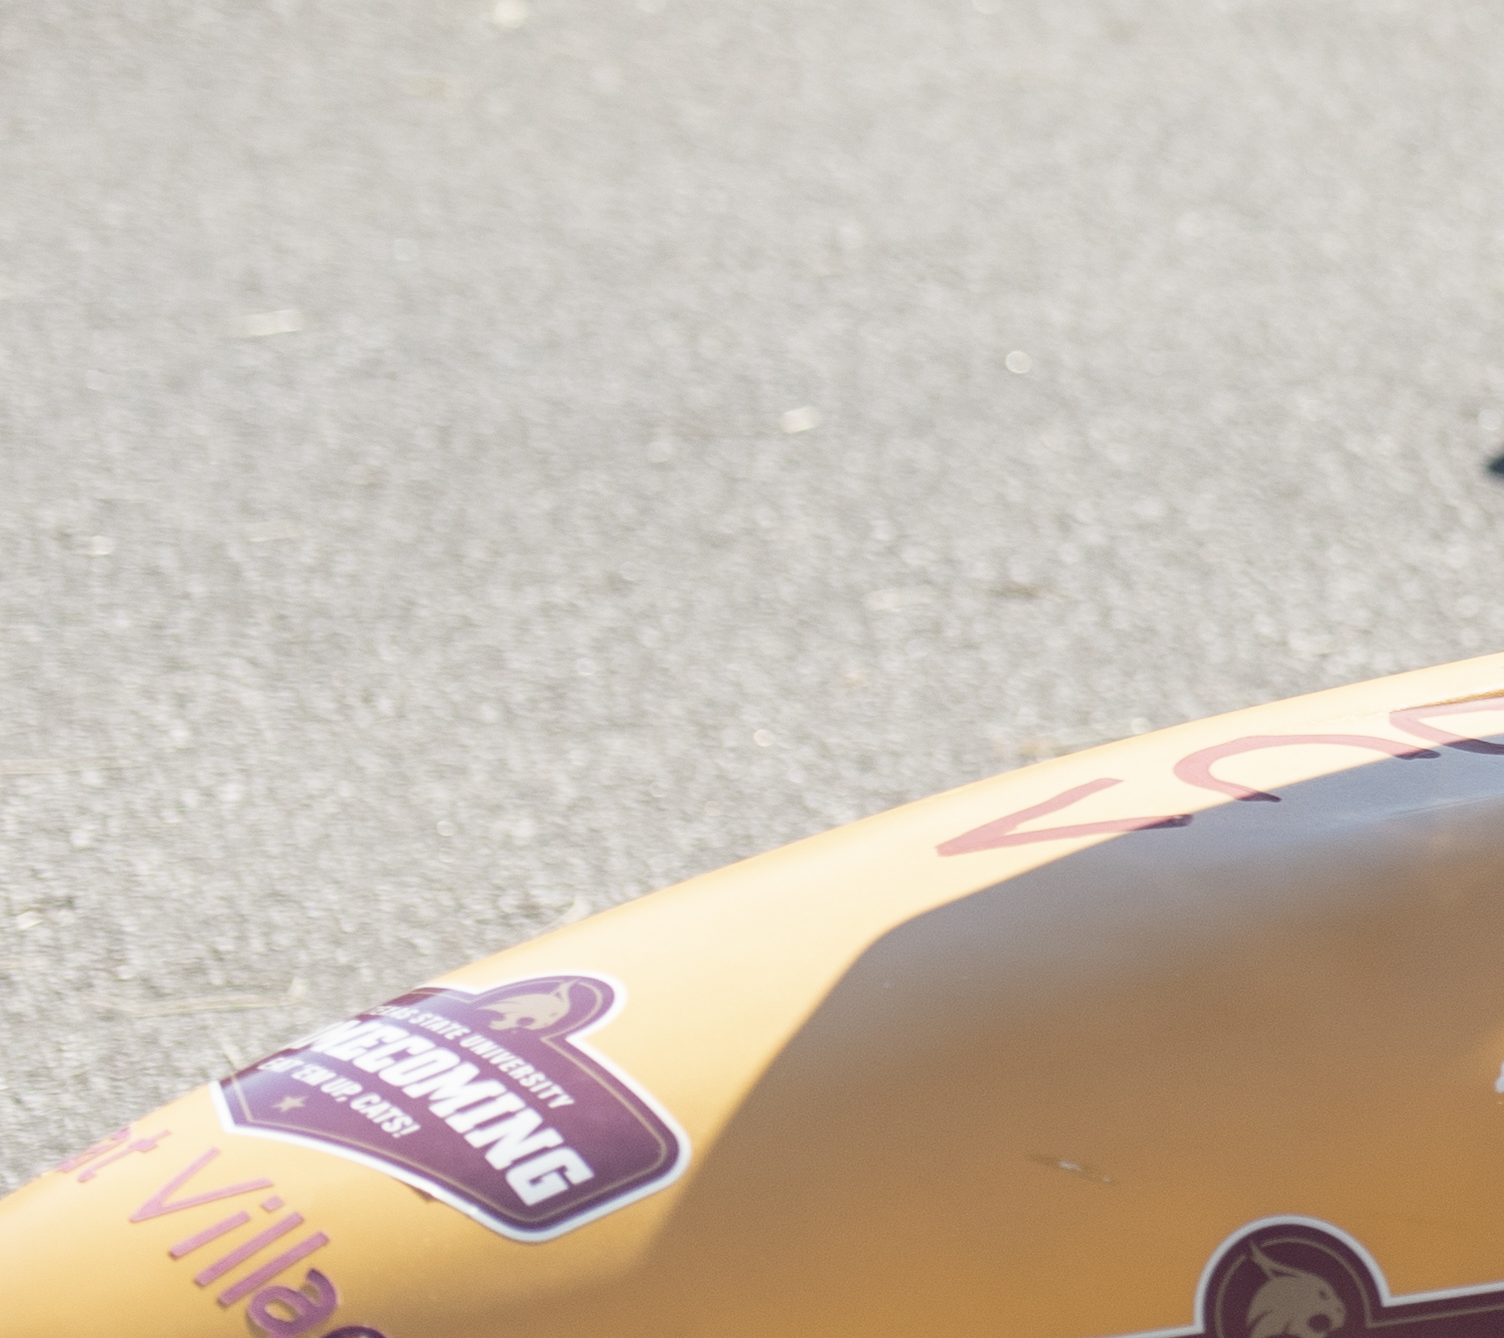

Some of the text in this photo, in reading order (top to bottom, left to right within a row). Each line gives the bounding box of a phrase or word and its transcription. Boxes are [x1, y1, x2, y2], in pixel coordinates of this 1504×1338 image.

[408, 1012, 472, 1041] STATE
[458, 1033, 576, 1109] UNIVERSITY
[320, 1077, 363, 1102] UP,
[349, 1091, 421, 1138] CATS!
